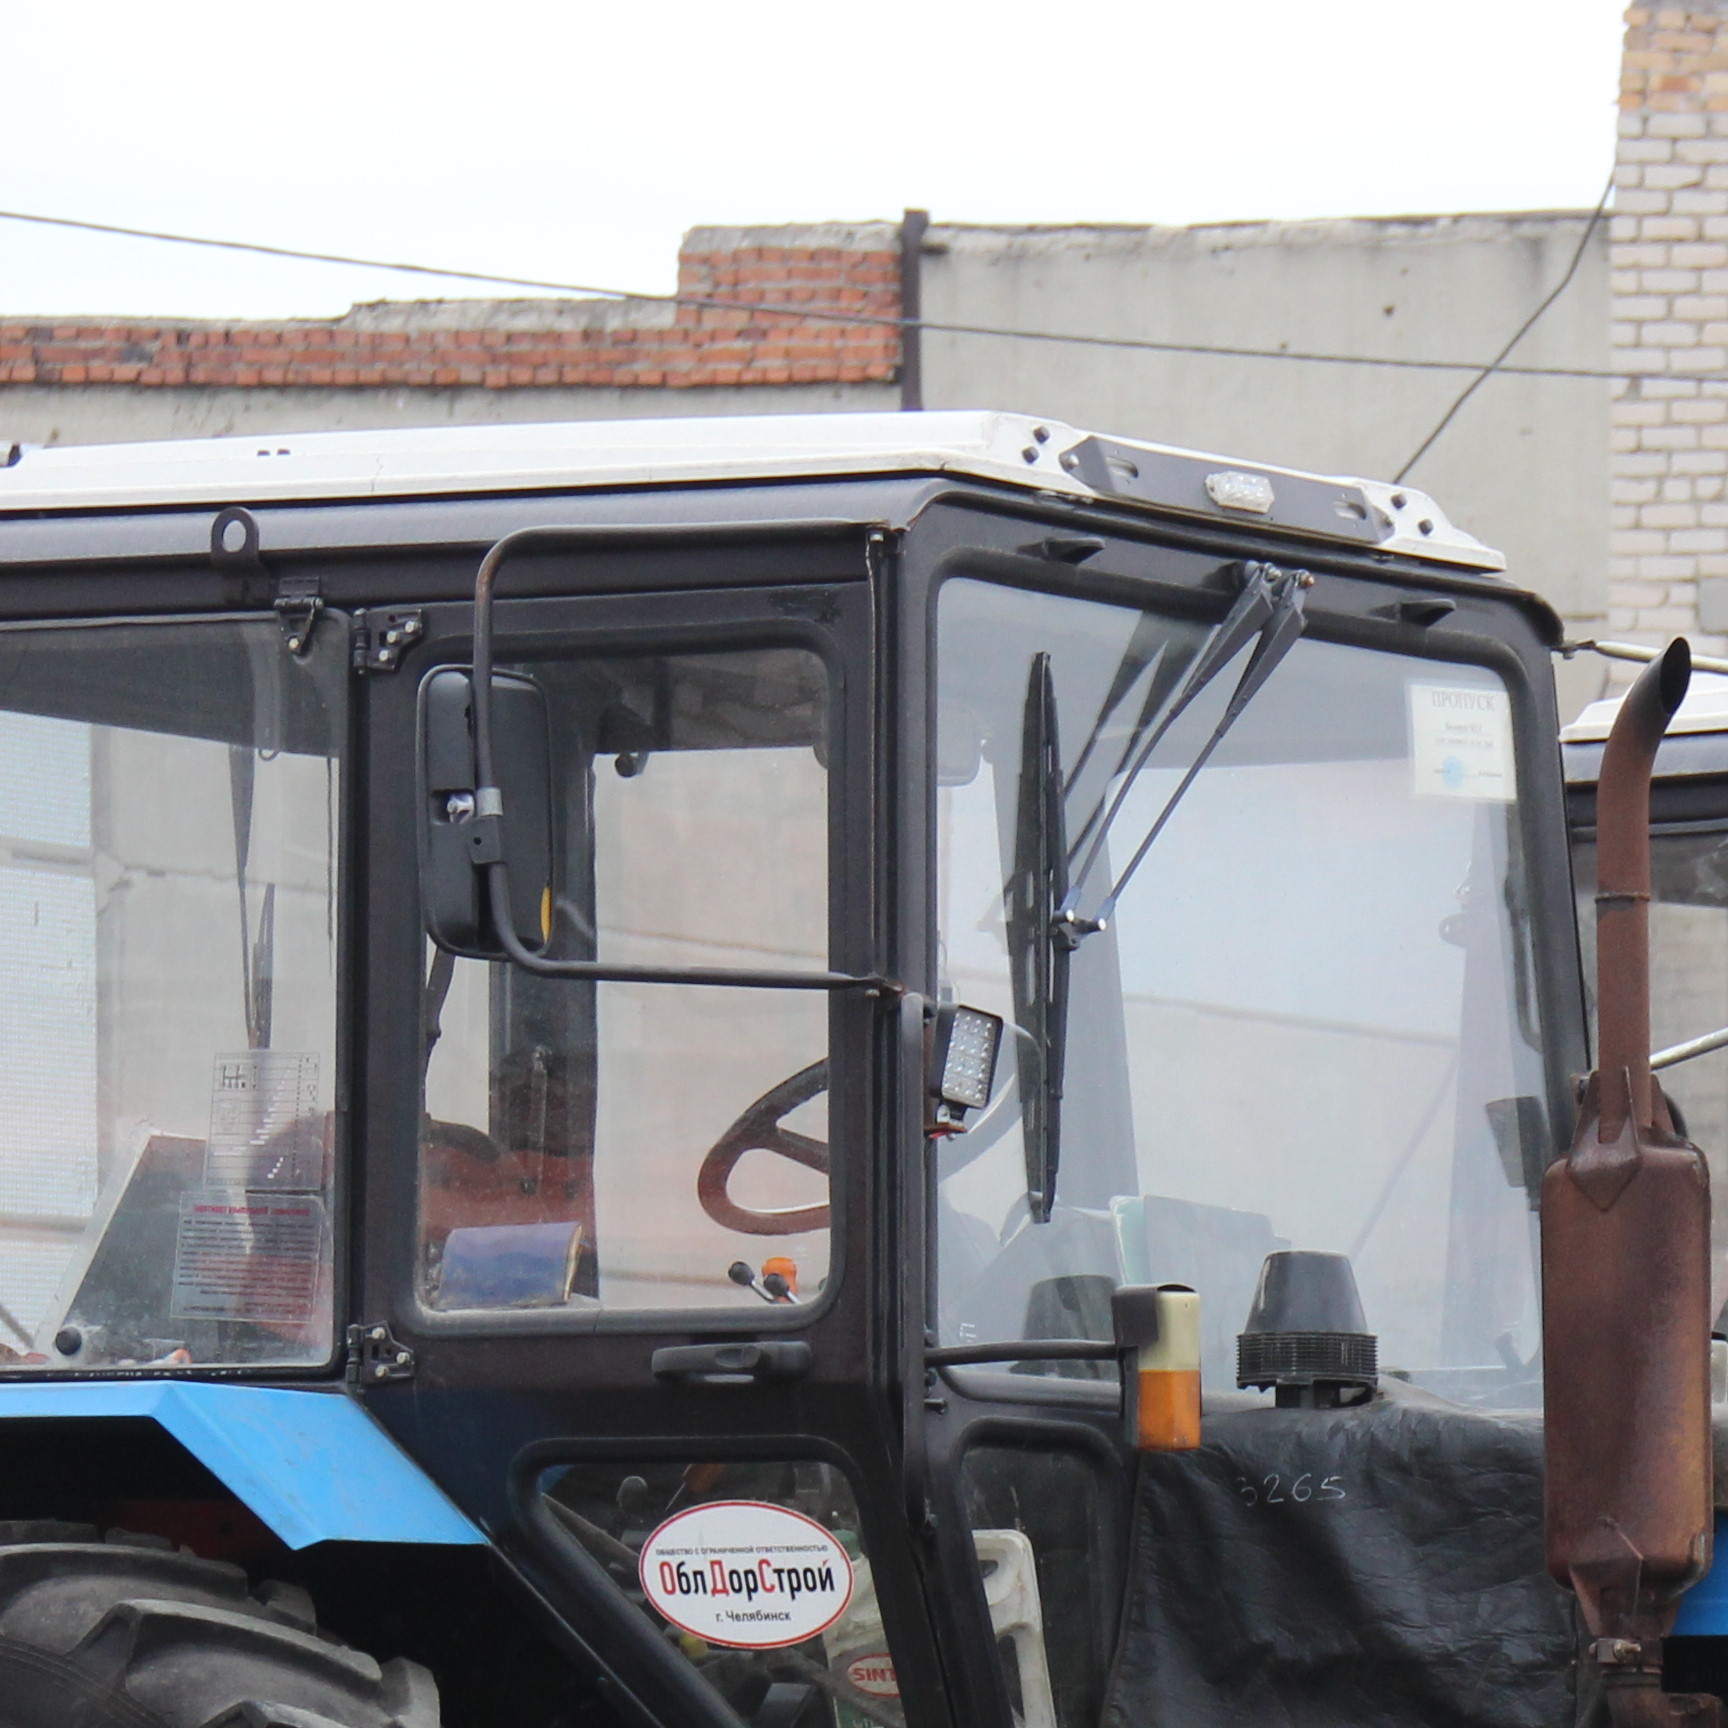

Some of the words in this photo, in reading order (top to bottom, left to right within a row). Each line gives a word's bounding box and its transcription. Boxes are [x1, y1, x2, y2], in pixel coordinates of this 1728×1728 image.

[1432, 690, 1496, 711] ПРОПУСК
[1236, 1472, 1346, 1507] 3265
[656, 1548, 694, 1556] ОБЩЕСТВО
[700, 1546, 755, 1555] ОГРАНИЧЕННОЙ
[755, 1545, 828, 1554] ОТВЕТСТВЕННОСТЬЮ
[659, 1558, 835, 1602] ОблДорСтрой
[715, 1612, 724, 1623] г.
[725, 1608, 792, 1623] Челябинск
